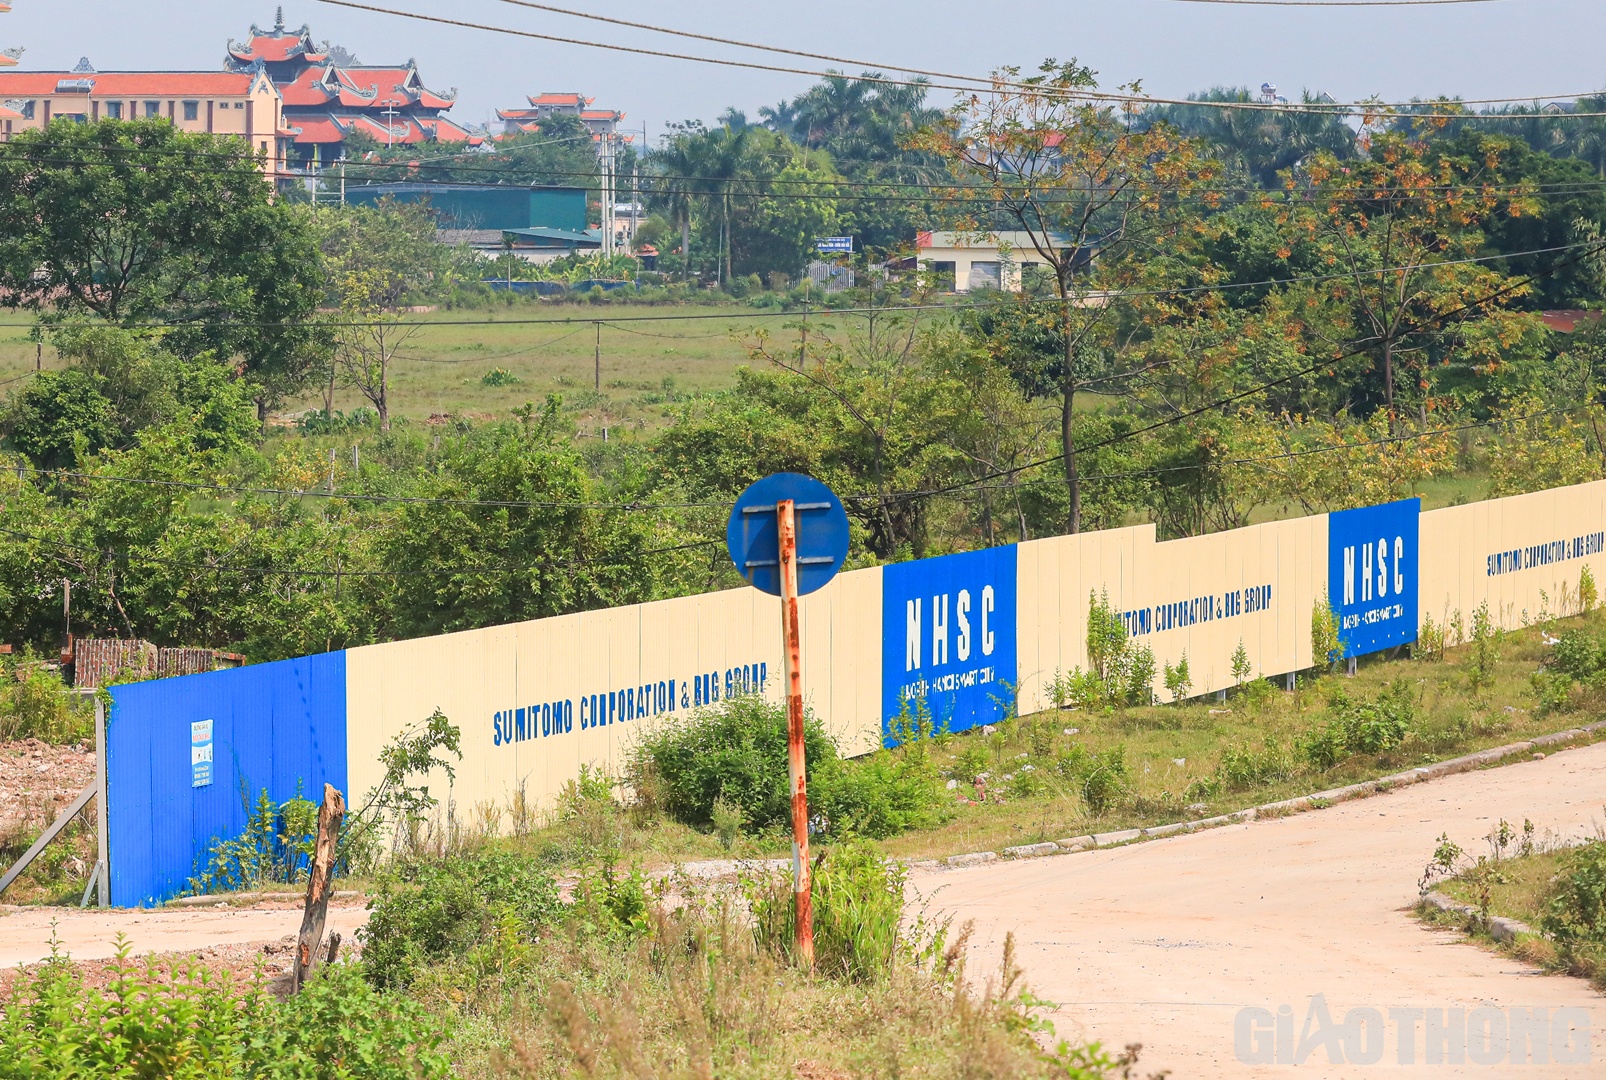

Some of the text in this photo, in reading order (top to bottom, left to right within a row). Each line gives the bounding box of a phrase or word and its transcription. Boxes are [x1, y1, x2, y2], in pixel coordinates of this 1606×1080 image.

[1343, 536, 1404, 606] NHSC
[1487, 548, 1523, 577] SUMITOMO
[1567, 541, 1571, 560] &
[906, 584, 995, 672] NHSC
[1155, 595, 1214, 633] CORPORATION
[1216, 597, 1222, 620] &
[1225, 590, 1240, 619] BIG
[1245, 584, 1272, 614] GROUP
[493, 662, 766, 747] SUMITOMO CORPORATION & BIG GROUP
